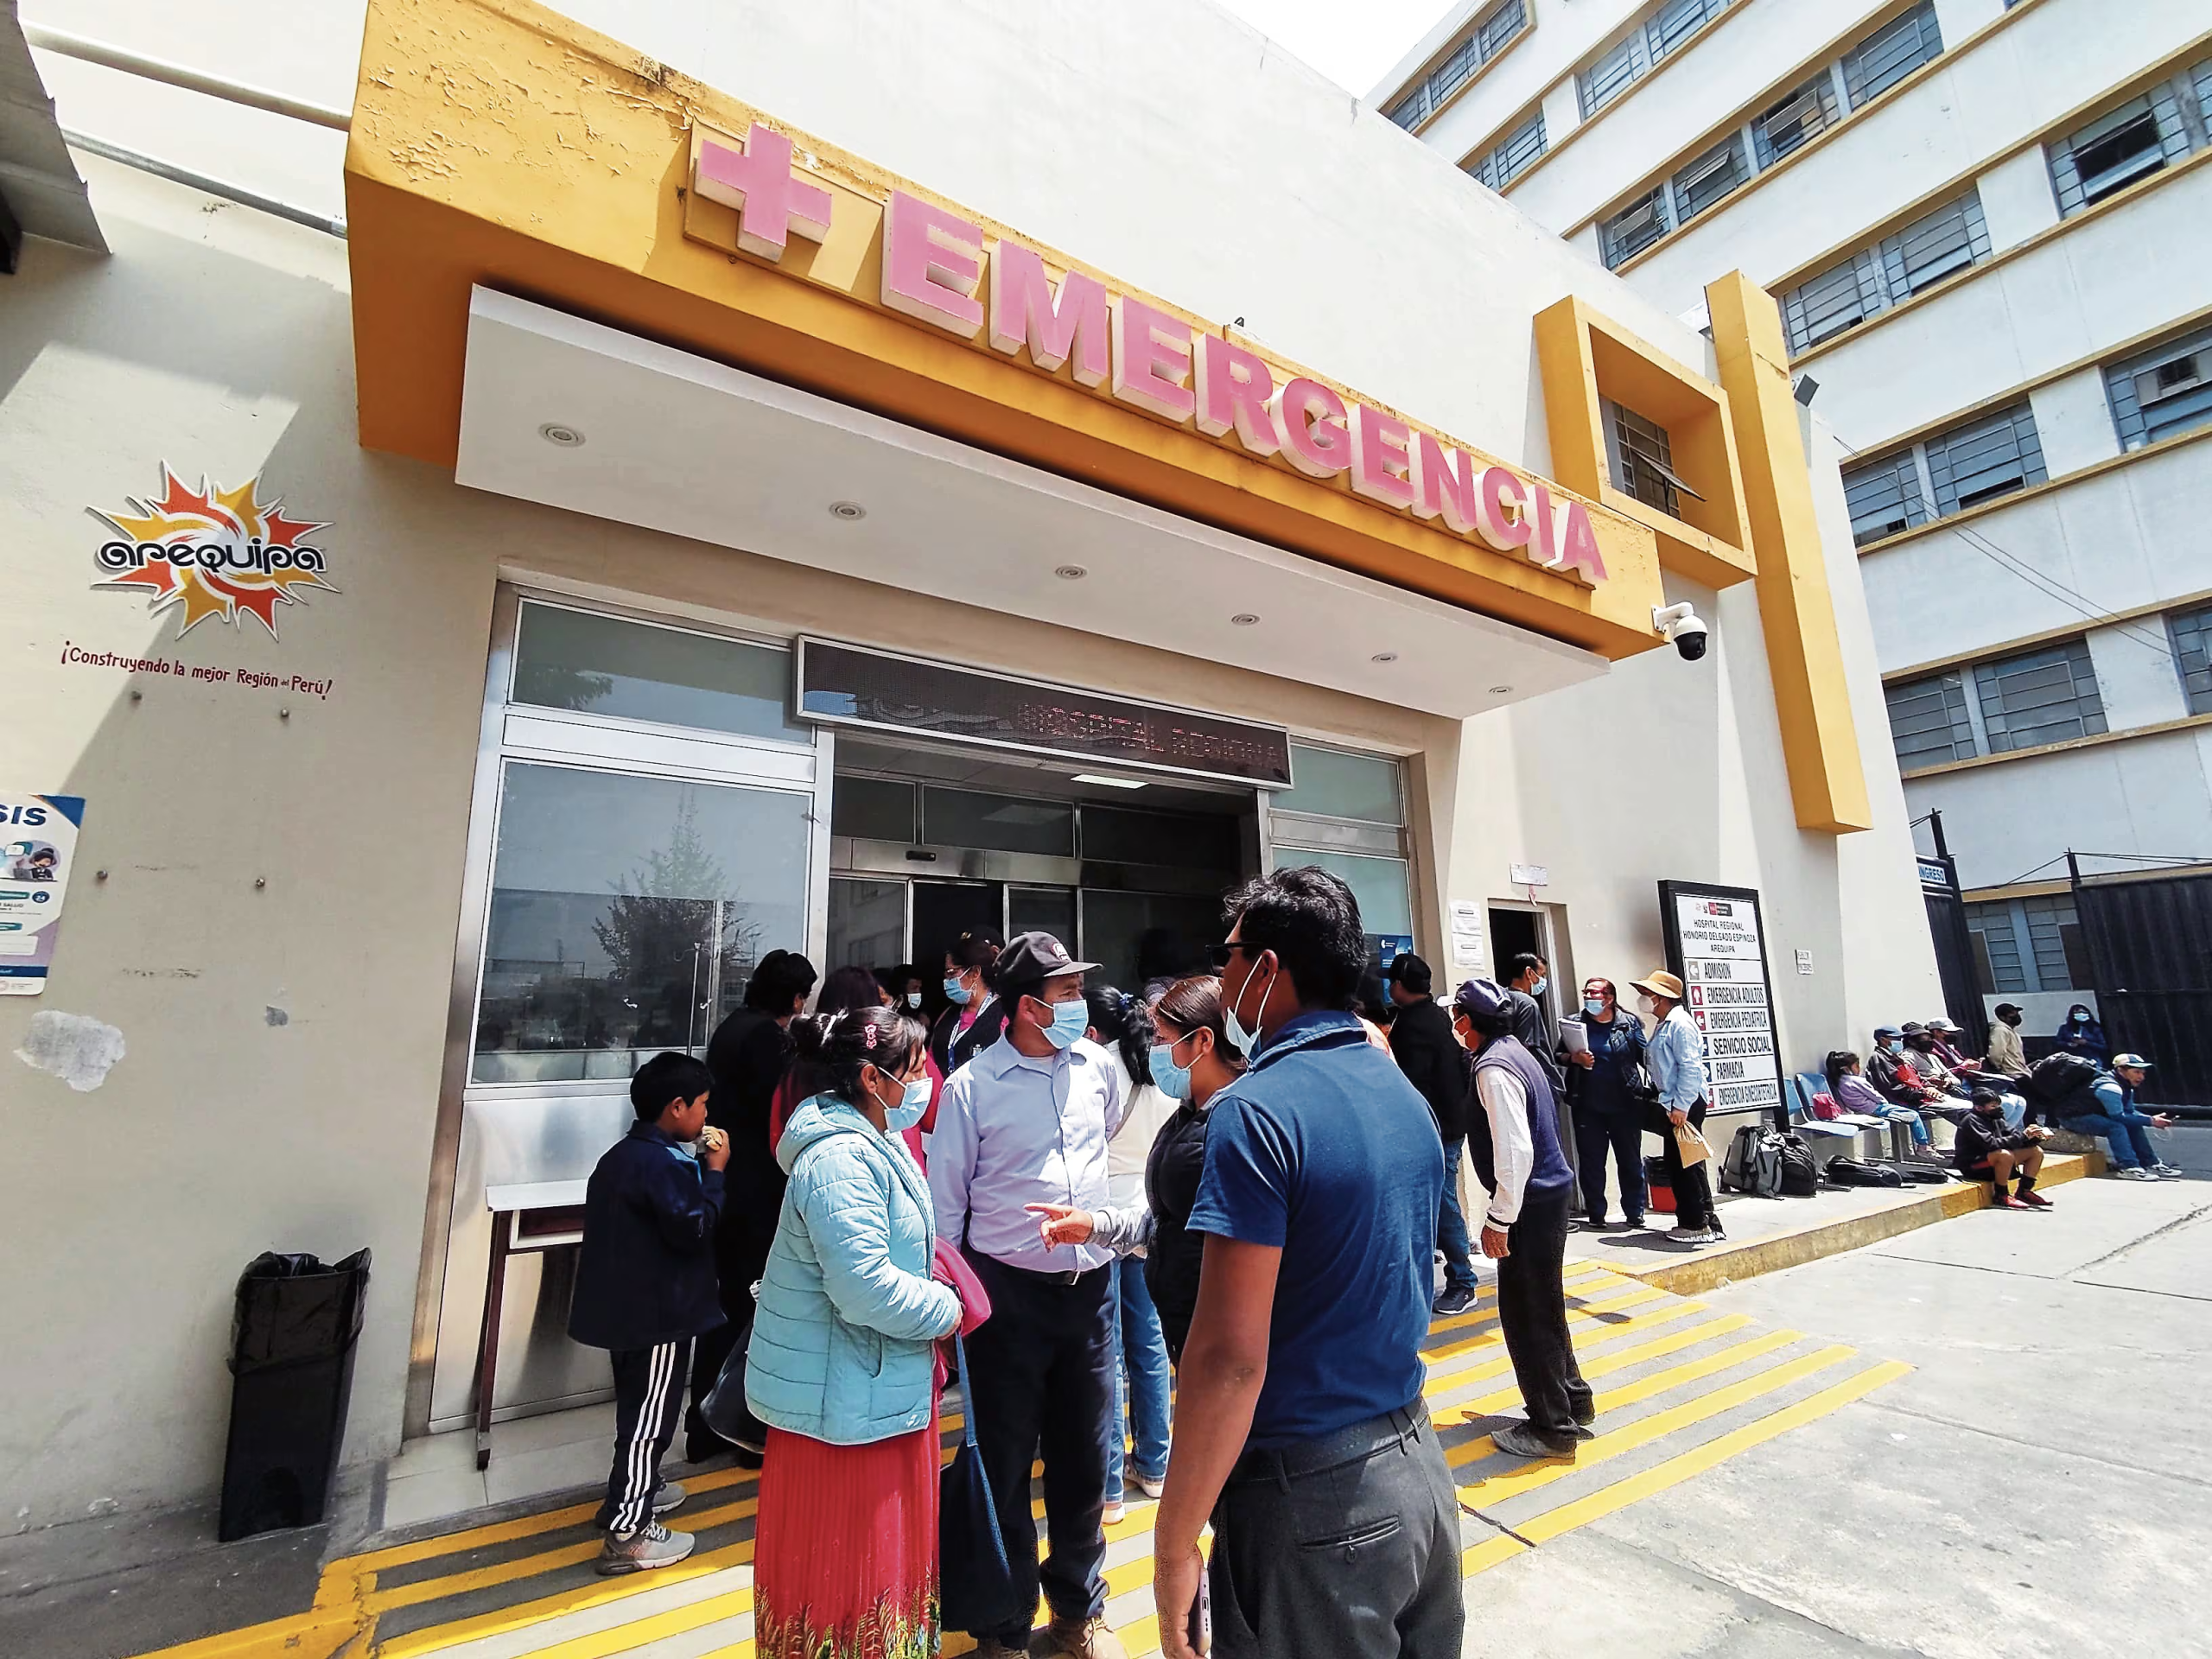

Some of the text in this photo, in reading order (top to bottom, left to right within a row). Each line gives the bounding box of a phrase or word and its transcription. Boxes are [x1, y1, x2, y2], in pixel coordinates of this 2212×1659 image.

[881, 188, 1608, 582] EMERGENCIA
[60, 640, 170, 673] ¡Construyendo
[174, 660, 185, 676] la
[191, 666, 231, 683] mejor
[237, 669, 278, 688] Región
[291, 676, 334, 701] Perú!
[1694, 918, 1719, 930] HOSPITAL
[1683, 931, 1708, 940] HONORIO
[1708, 931, 1732, 942] DELGADO
[1710, 944, 1736, 953] AREQUIPA
[1704, 962, 1732, 980] ADMISION
[1707, 987, 1764, 1004] EMERGENCIA ADULTOS
[1710, 1011, 1768, 1029] EMERGENCIA PEDIATRICA
[1713, 1036, 1772, 1056] SERVICIO SOCIAL
[1716, 1060, 1745, 1080] FARMACIA
[1719, 1086, 1745, 1106] EMERGENCIA
